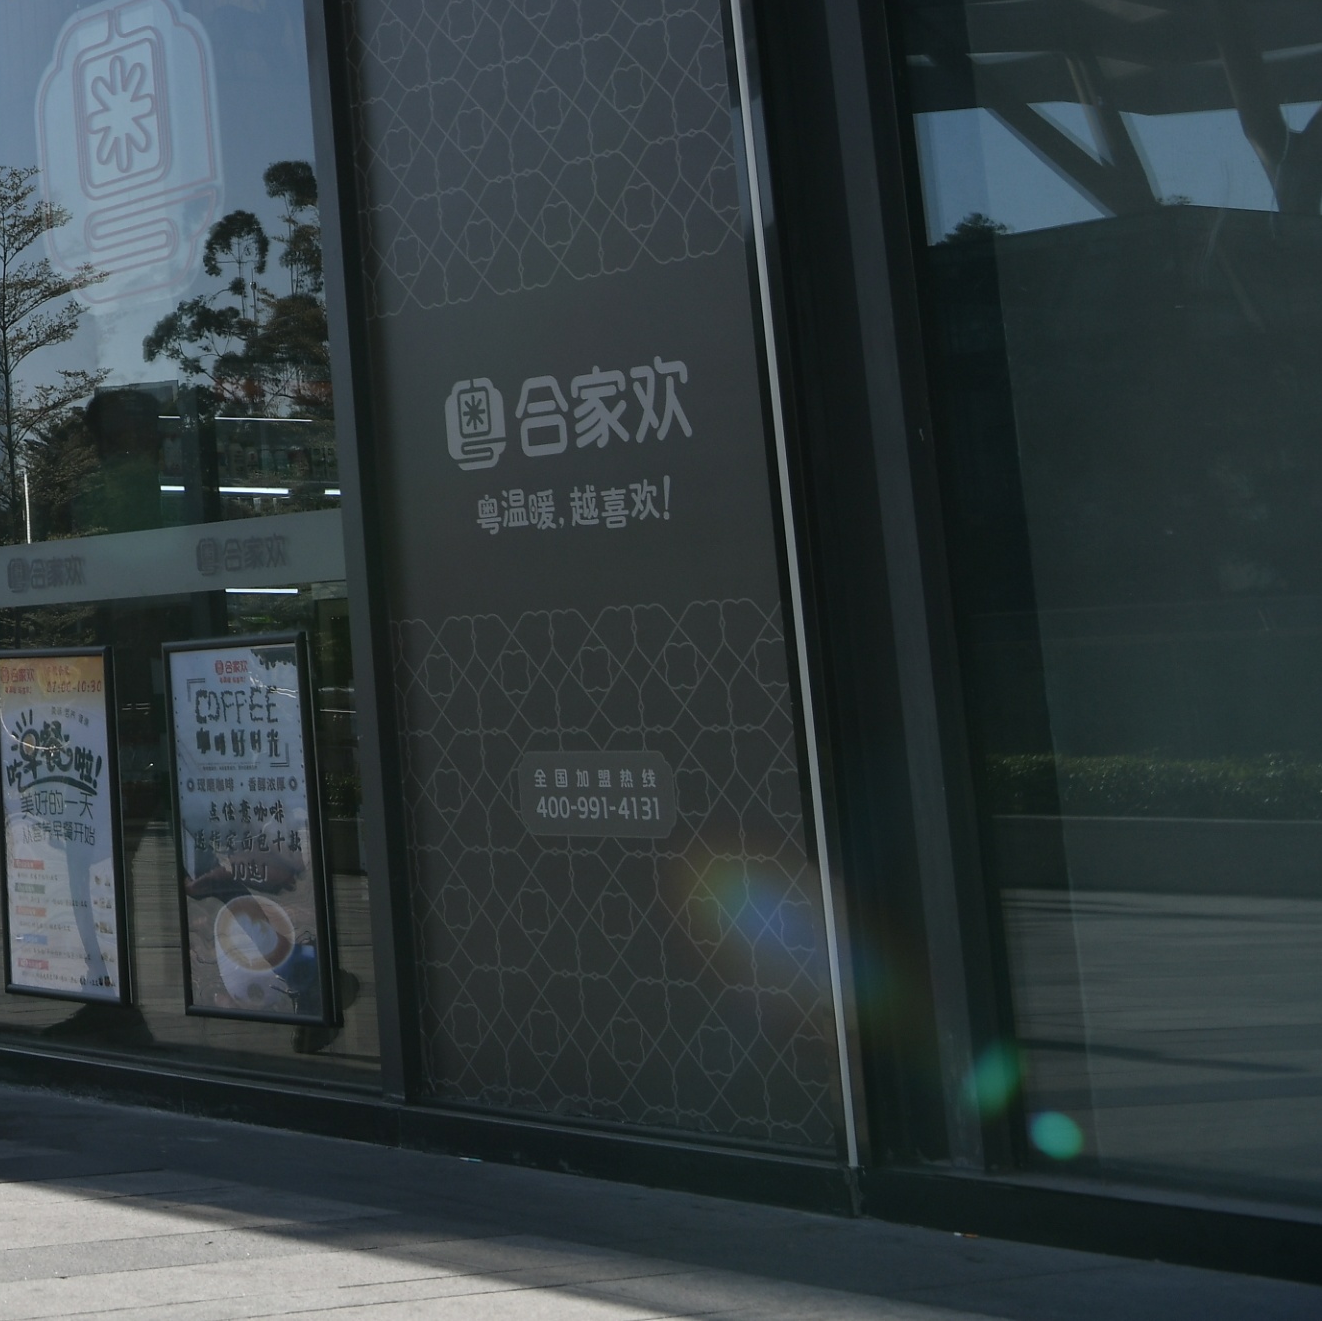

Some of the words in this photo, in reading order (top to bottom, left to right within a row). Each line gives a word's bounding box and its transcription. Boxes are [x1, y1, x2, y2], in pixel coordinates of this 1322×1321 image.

[515, 355, 693, 457] 合家欢
[223, 533, 289, 571] 合家欢
[30, 554, 86, 589] 合家欢
[195, 685, 279, 724] COFFEE
[534, 768, 657, 789] 全国加盟热线
[20, 790, 94, 820] 美好的一天
[536, 796, 661, 822] 400-991-4131
